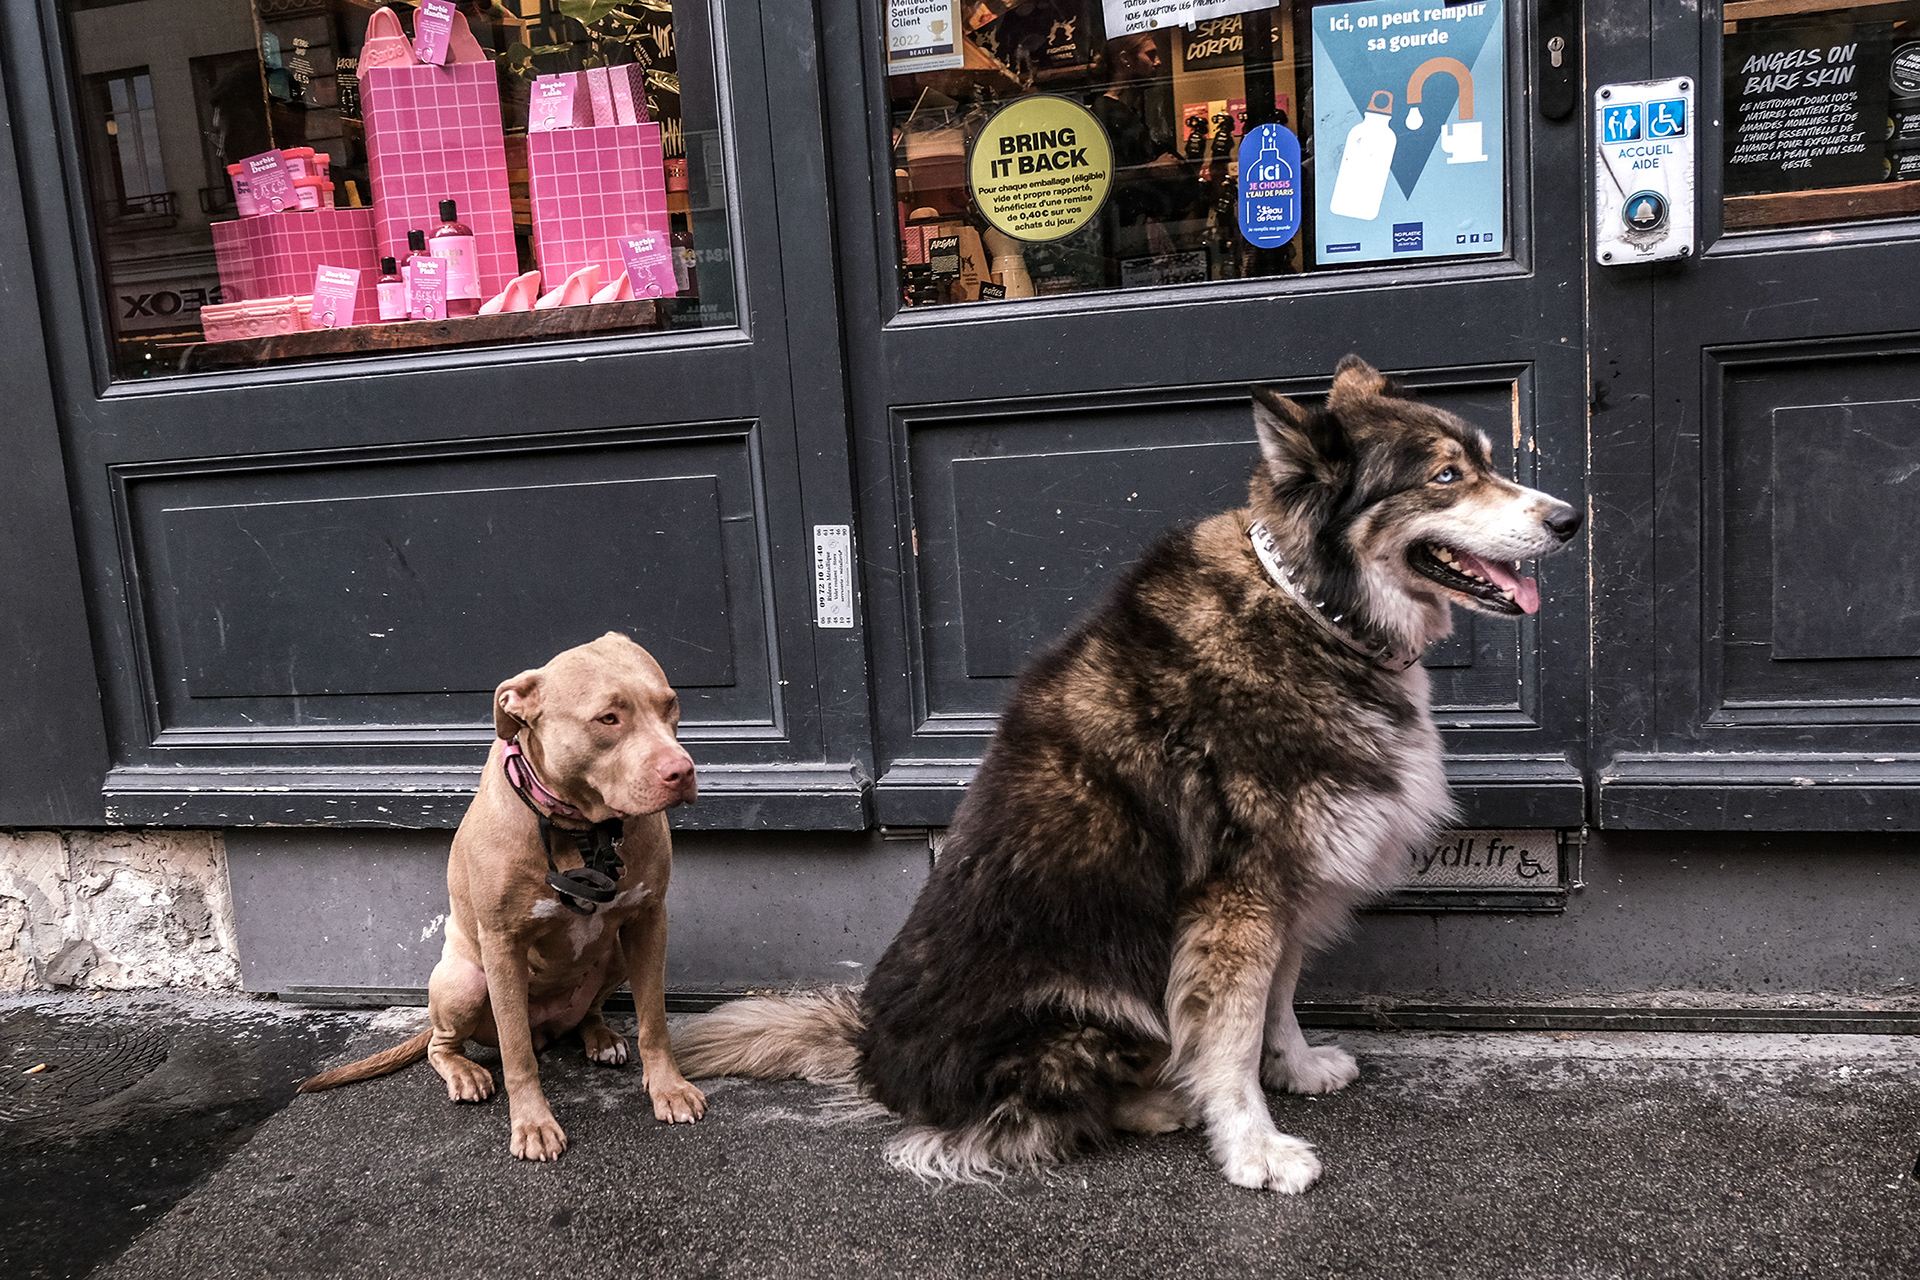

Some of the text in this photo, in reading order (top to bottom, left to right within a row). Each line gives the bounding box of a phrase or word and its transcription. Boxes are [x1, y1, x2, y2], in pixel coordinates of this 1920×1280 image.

[424, 8, 450, 22] Handbag
[428, 3, 448, 14] Barbie
[891, 3, 948, 18] Satisfaction
[1142, 4, 1177, 18] ACCEPTONS
[1179, 2, 1191, 10] LES
[891, 16, 922, 28] Client
[1330, 3, 1487, 32] Ici, on peut remplir
[892, 34, 920, 48] 2022
[1368, 28, 1449, 53] sa gourde
[1740, 44, 1858, 74] ANGELS ON
[540, 82, 566, 90] Barbie
[1742, 65, 1856, 96] BARE SKIN
[1739, 91, 1858, 112] CE NETTOYANT DOUX 100%
[1744, 102, 1852, 122] NATUREL CONTIENT DES
[1738, 112, 1860, 133] AMANDES MOULUES ET DE
[1743, 124, 1854, 142] L'HUILE ESSENTIELLE DE
[999, 128, 1076, 156] BRING
[1734, 132, 1866, 154] LAVANDE POUR EXFOLIER ET
[1618, 144, 1673, 158] ACCUEIL
[1730, 144, 1866, 164] APAISER LA PEAU EN UN SEUL
[250, 156, 276, 168] Barbie
[252, 162, 278, 174] Dream
[990, 148, 1089, 178] IT BACK
[1632, 158, 1660, 170] AIDE
[1780, 159, 1813, 171] GESTE.
[978, 171, 1106, 195] Pour chaque emballage (éligible)
[1249, 182, 1258, 190] JE
[993, 184, 1092, 204] vide et propre rapporté,
[1246, 190, 1264, 198] L'EAU
[1265, 188, 1274, 197] DE
[994, 194, 1093, 214] bénéficiez d'une remise
[1007, 212, 1018, 222] de
[1050, 208, 1064, 216] sur
[1066, 206, 1082, 214] vos
[1256, 214, 1266, 222] de
[1014, 216, 1076, 231] achats du jour.
[628, 237, 656, 248] Barbie
[634, 244, 654, 254] Heel
[930, 238, 958, 250] ARGAN
[416, 260, 438, 270] Barbie
[420, 267, 436, 275] Pink
[320, 275, 356, 287] Boombox
[326, 270, 351, 281] Barbie
[817, 545, 823, 556] 40
[818, 572, 824, 581] 10
[819, 583, 825, 594] 72
[820, 597, 825, 608] 09
